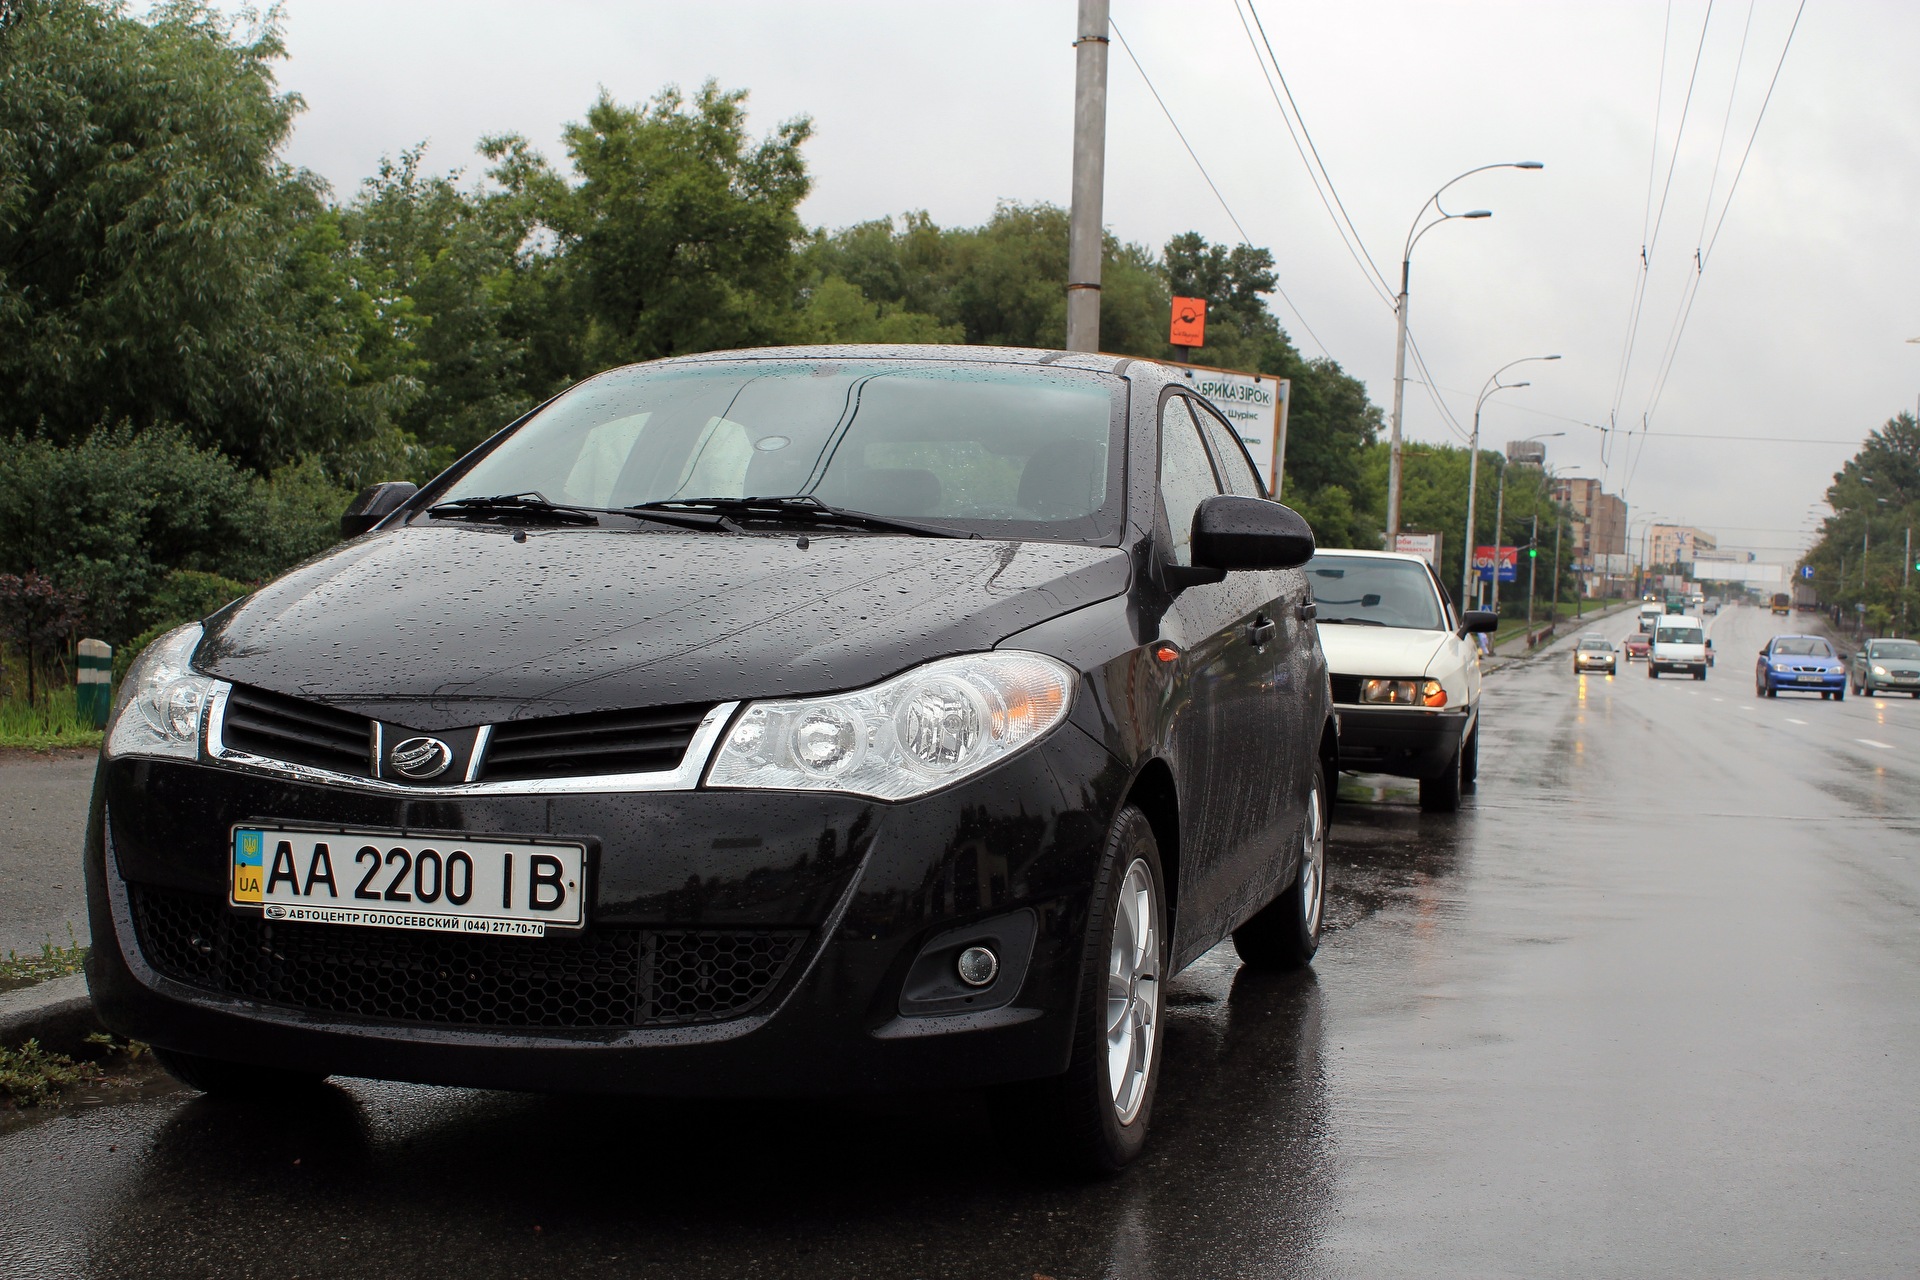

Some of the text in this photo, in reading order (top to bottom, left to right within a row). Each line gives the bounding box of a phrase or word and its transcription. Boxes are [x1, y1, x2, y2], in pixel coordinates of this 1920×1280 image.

[1239, 386, 1269, 403] ЗІРОК
[239, 877, 260, 893] UA
[266, 840, 567, 912] AA 2200 IB
[289, 909, 544, 936] АВТОЦЕНТР ГОЛОСЕЕВСКИЙ (044) 277-70-70
